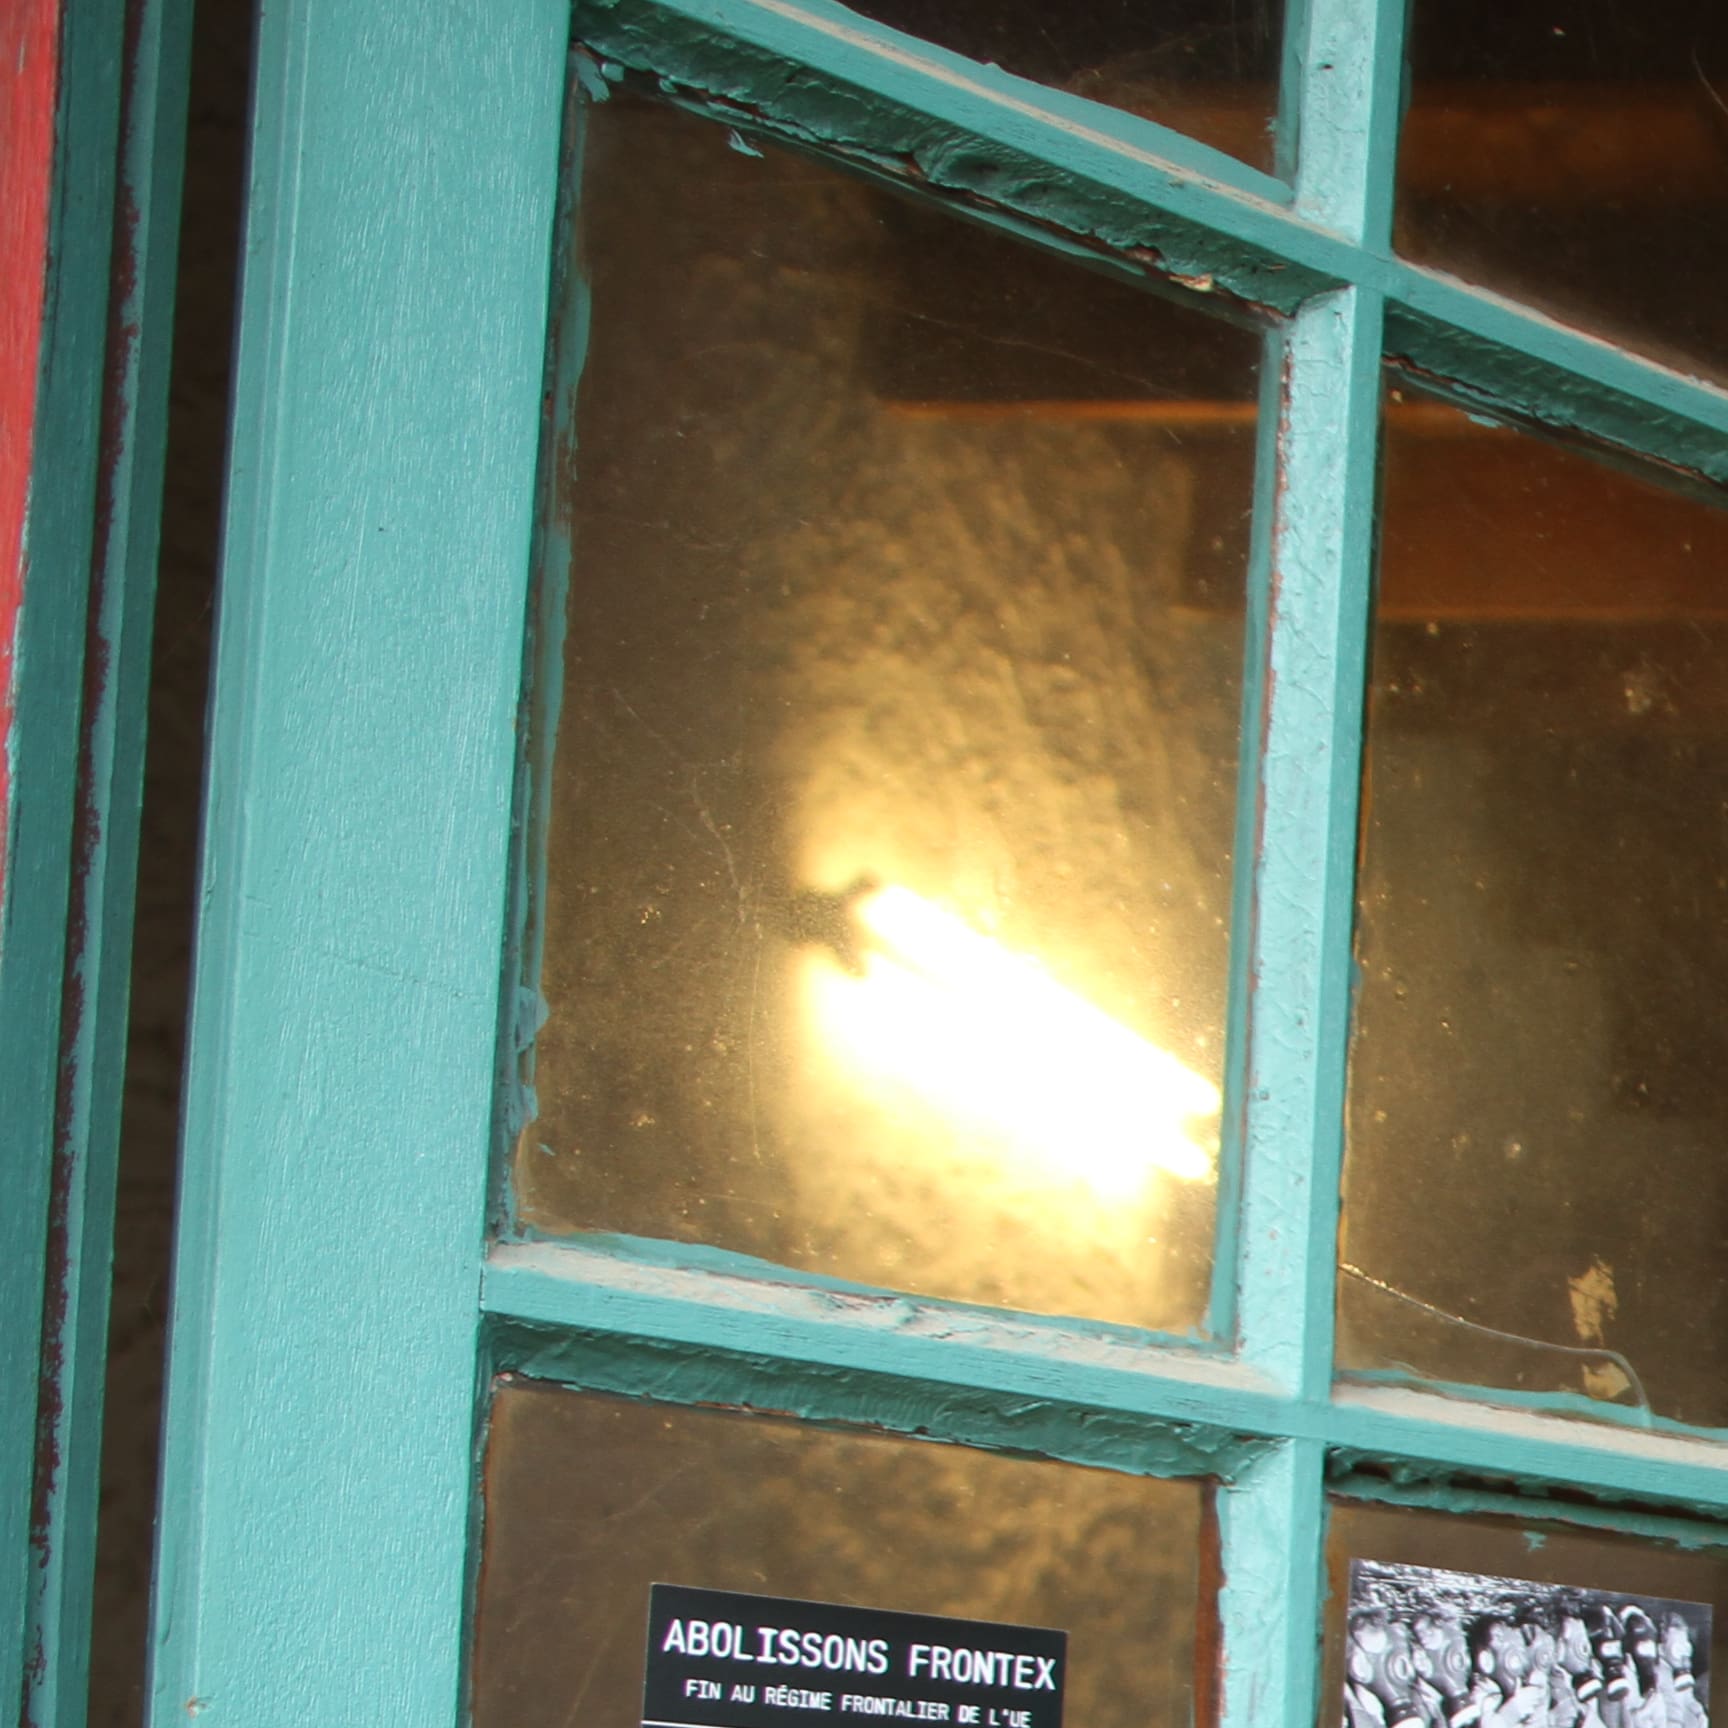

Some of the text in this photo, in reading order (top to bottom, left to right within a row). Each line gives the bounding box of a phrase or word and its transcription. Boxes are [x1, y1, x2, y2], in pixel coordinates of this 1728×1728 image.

[663, 1618, 1056, 1691] ABOLISSONS FRONTEX
[686, 1679, 1031, 1728] FIN AU RÉGIME FRONTALIER DE L'UE
